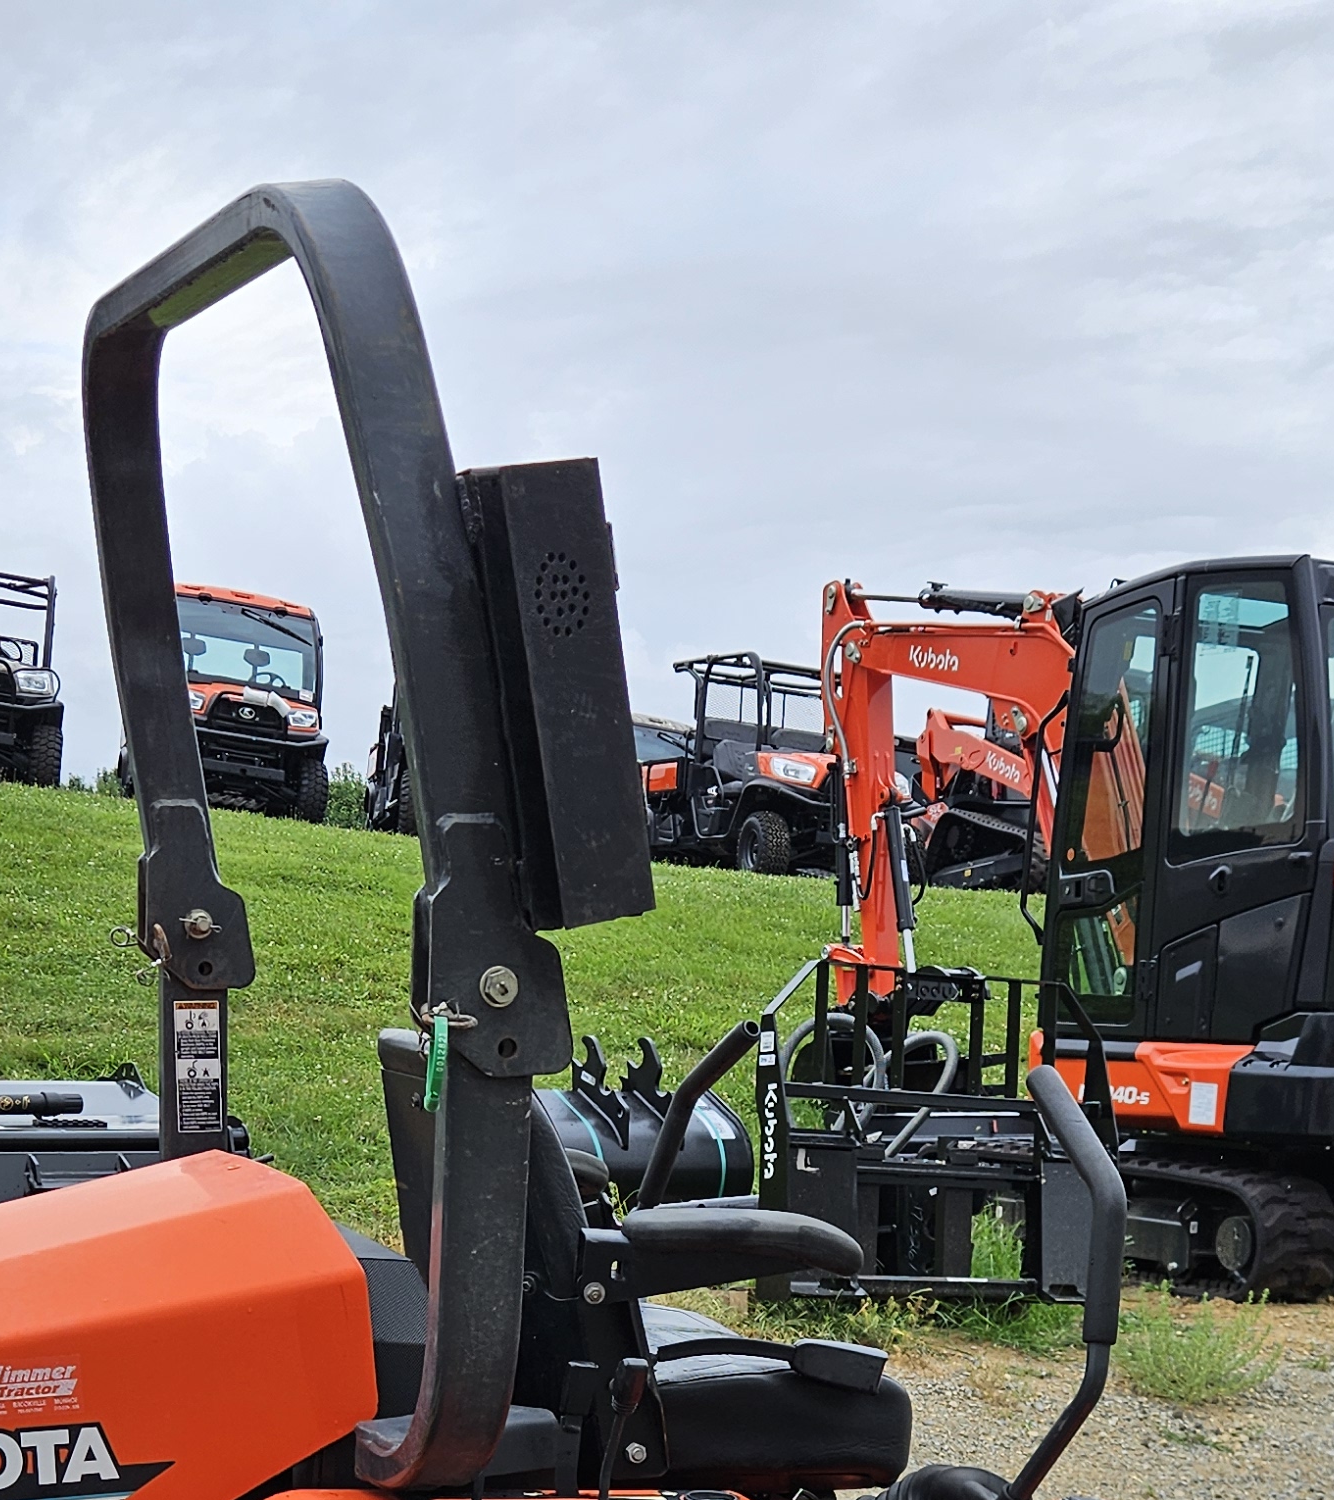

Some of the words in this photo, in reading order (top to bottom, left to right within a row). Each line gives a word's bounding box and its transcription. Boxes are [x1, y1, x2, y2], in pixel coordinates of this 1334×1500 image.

[908, 644, 959, 672] Kubota
[986, 751, 1021, 783] Kubota
[763, 1082, 778, 1180] Kubota
